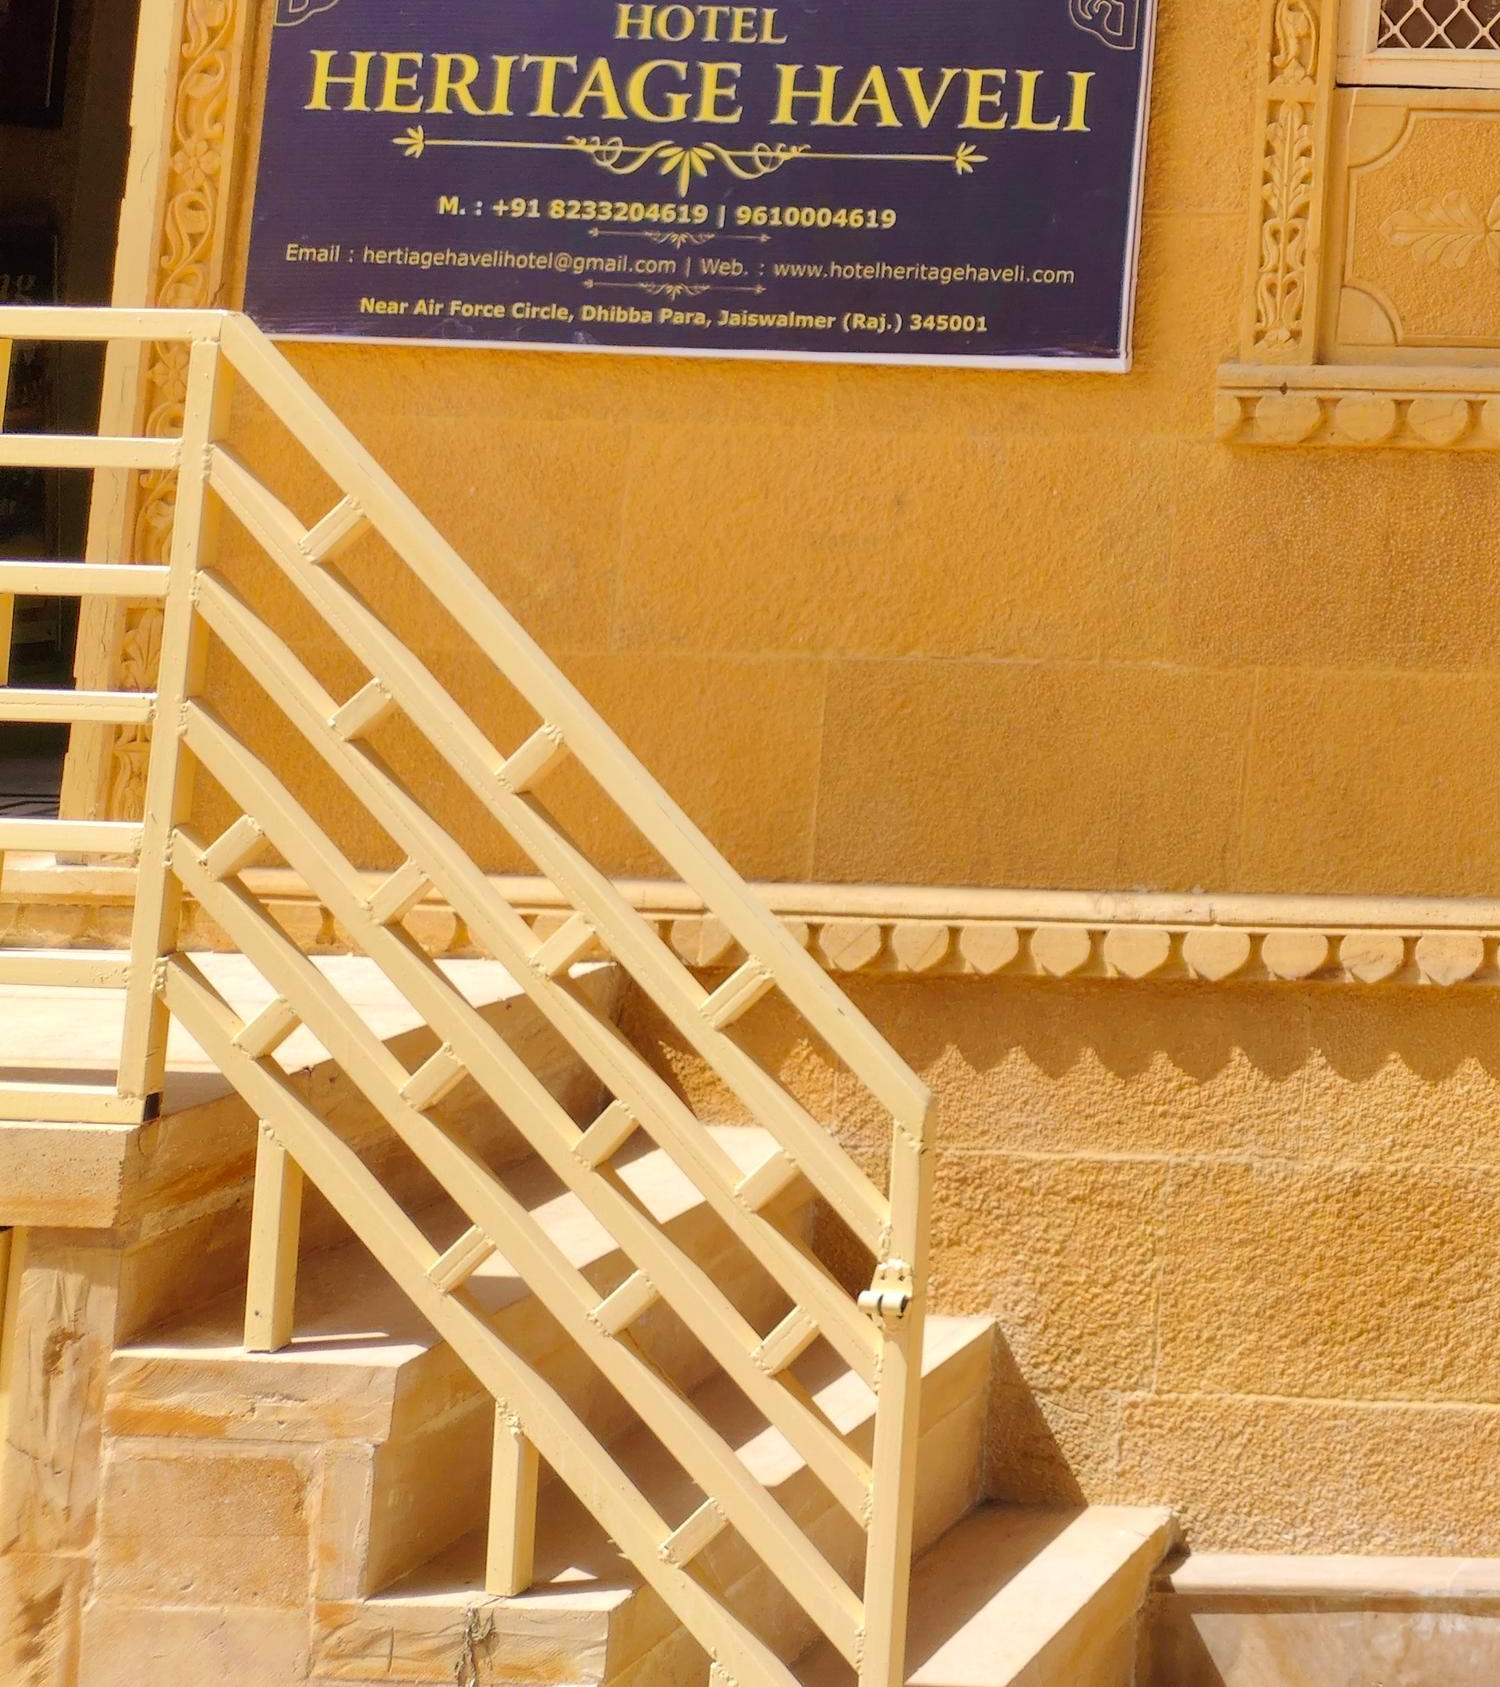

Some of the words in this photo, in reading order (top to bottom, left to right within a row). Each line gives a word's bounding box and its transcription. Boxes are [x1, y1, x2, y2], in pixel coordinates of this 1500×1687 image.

[614, 2, 788, 45] HOTEL
[304, 49, 743, 125] HERITAGE
[769, 64, 1096, 133] HAVELI
[492, 197, 540, 219] +91
[549, 199, 709, 225] 8233204619
[735, 205, 898, 230] 9610004619
[286, 243, 340, 263] Email
[363, 246, 677, 274] hertiagehavelihotel@gmail.com
[701, 257, 749, 277] Web.
[774, 261, 1076, 284] www.hotelheritagehaveli.com
[359, 296, 408, 314] Near
[413, 299, 444, 316] Air
[450, 301, 506, 318] Force
[511, 302, 575, 322] Circle,
[581, 305, 653, 324] Dhibba
[659, 308, 712, 328] Para,
[717, 310, 837, 329] Jaiswalmer
[842, 313, 903, 334] (Raj.)
[909, 314, 989, 332] 345001
